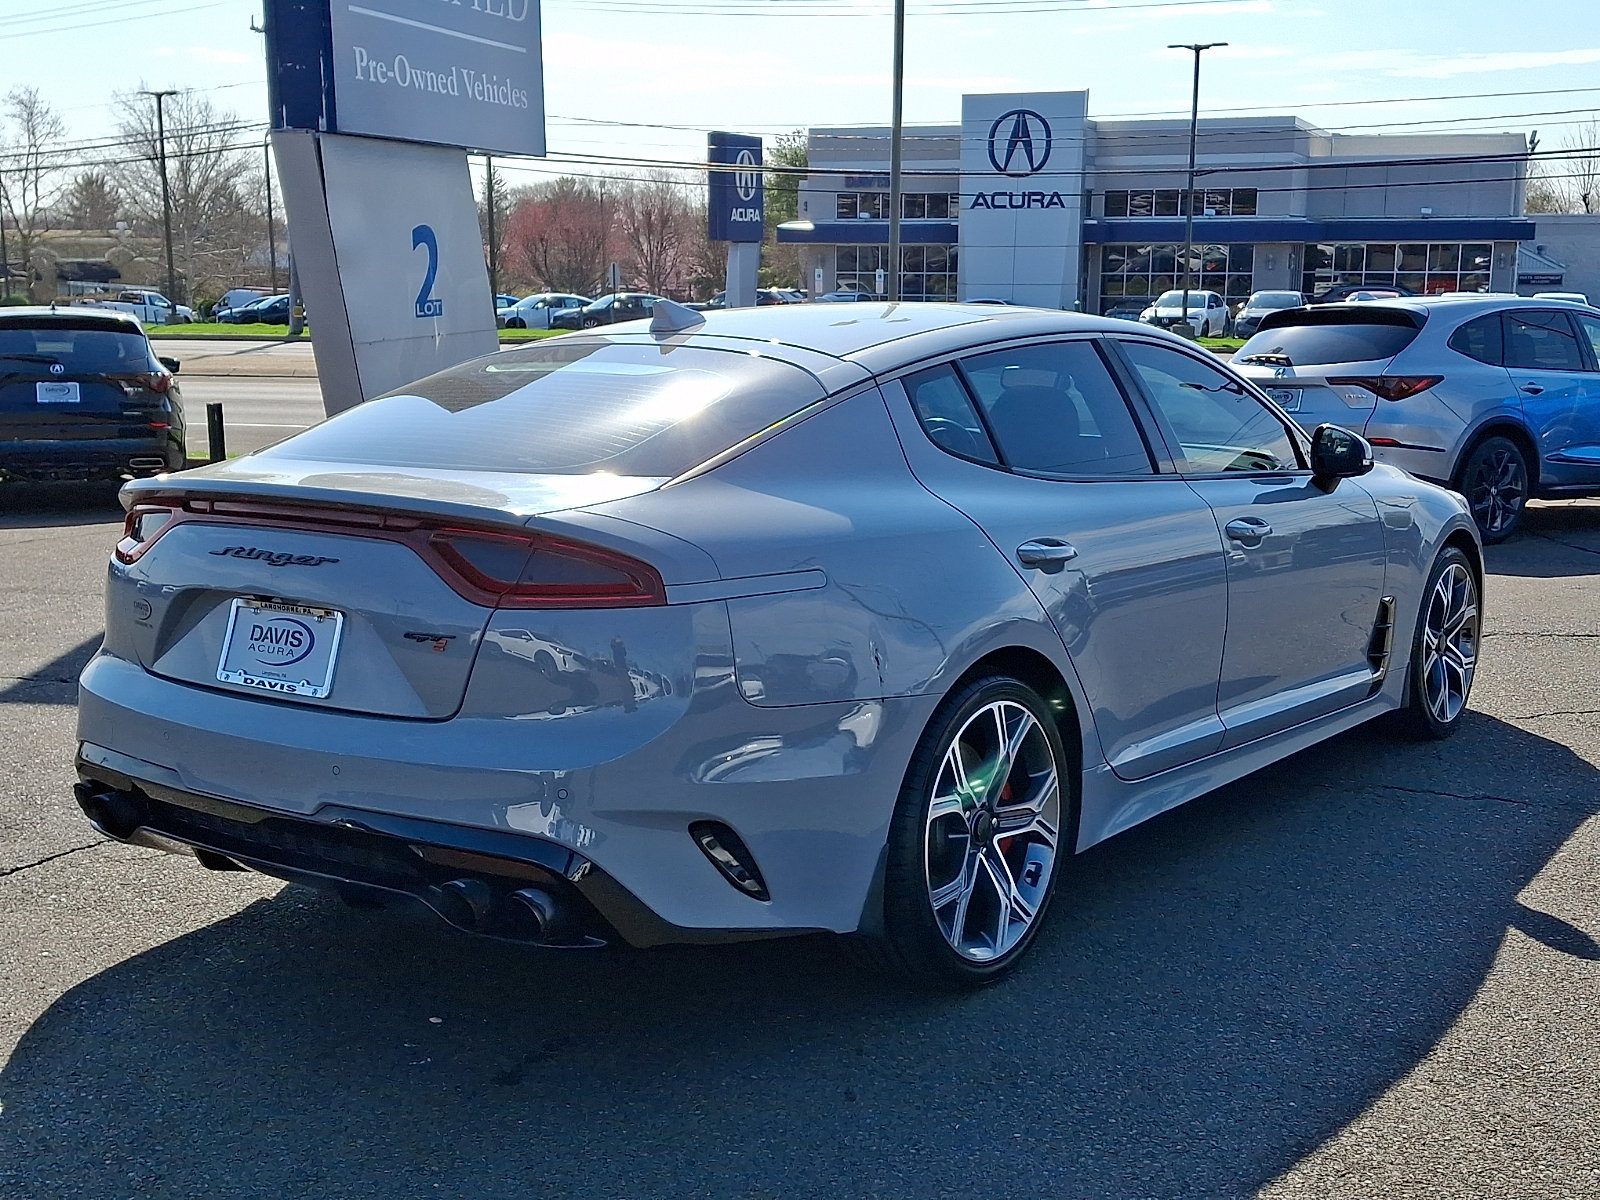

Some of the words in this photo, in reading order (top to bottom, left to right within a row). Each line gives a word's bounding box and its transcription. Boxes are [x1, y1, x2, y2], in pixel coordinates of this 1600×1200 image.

[352, 46, 459, 97] Pre-Owned
[460, 67, 528, 109] Vehicles
[969, 191, 1066, 209] ACURA
[730, 207, 761, 222] ACURA
[412, 224, 442, 318] 2
[416, 301, 442, 316] LOT
[249, 624, 304, 648] DAVIS
[247, 642, 295, 658] ACURA
[243, 677, 297, 692] DAVIS
